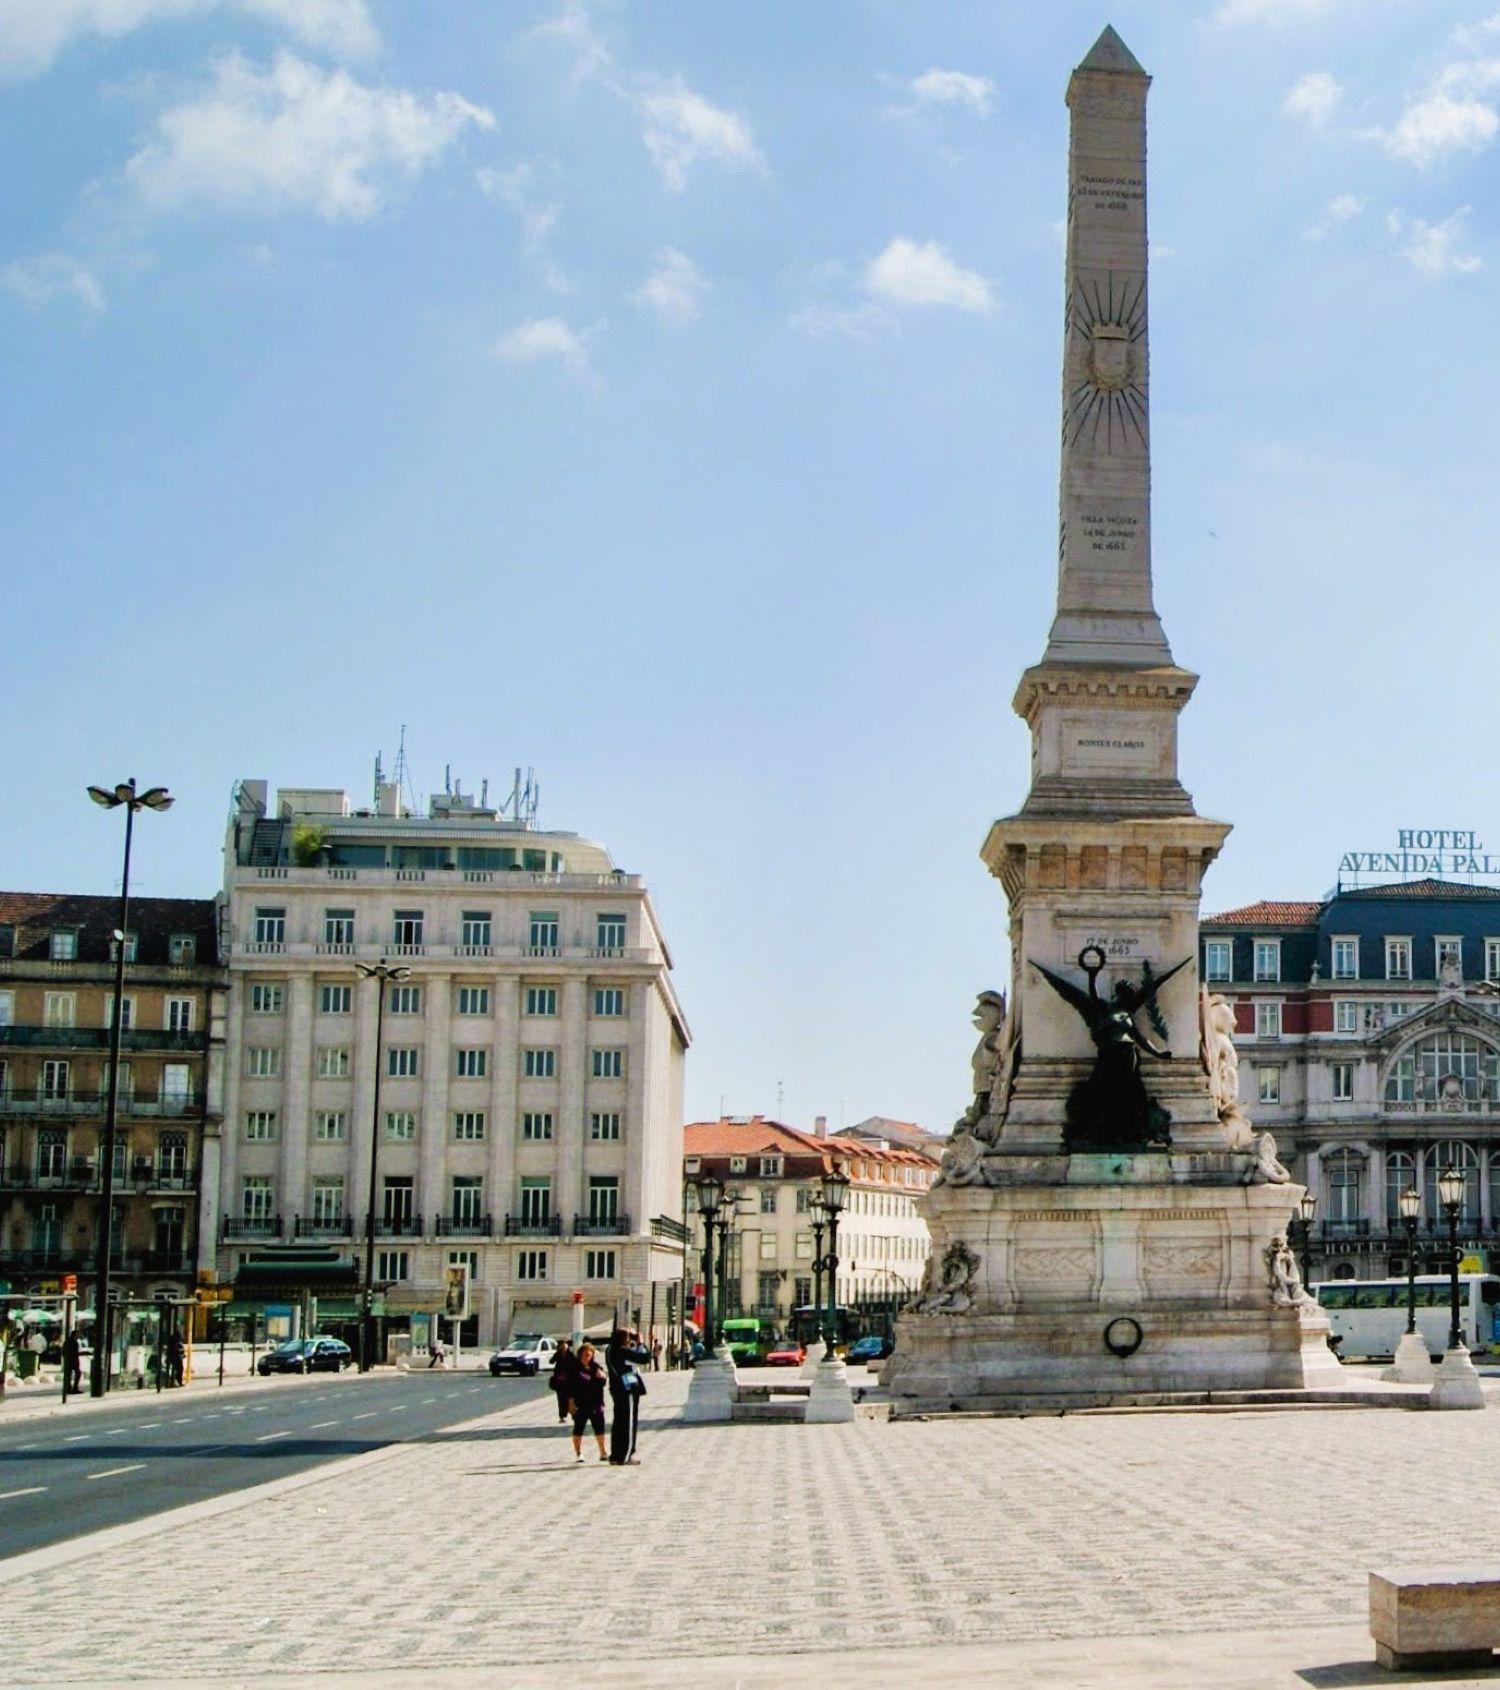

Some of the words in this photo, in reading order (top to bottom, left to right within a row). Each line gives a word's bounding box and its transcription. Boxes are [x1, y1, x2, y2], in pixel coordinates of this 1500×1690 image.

[1398, 829, 1483, 850] HOTEL
[1339, 853, 1443, 873] AVENIDA
[1325, 1241, 1390, 1256] HOTEL
